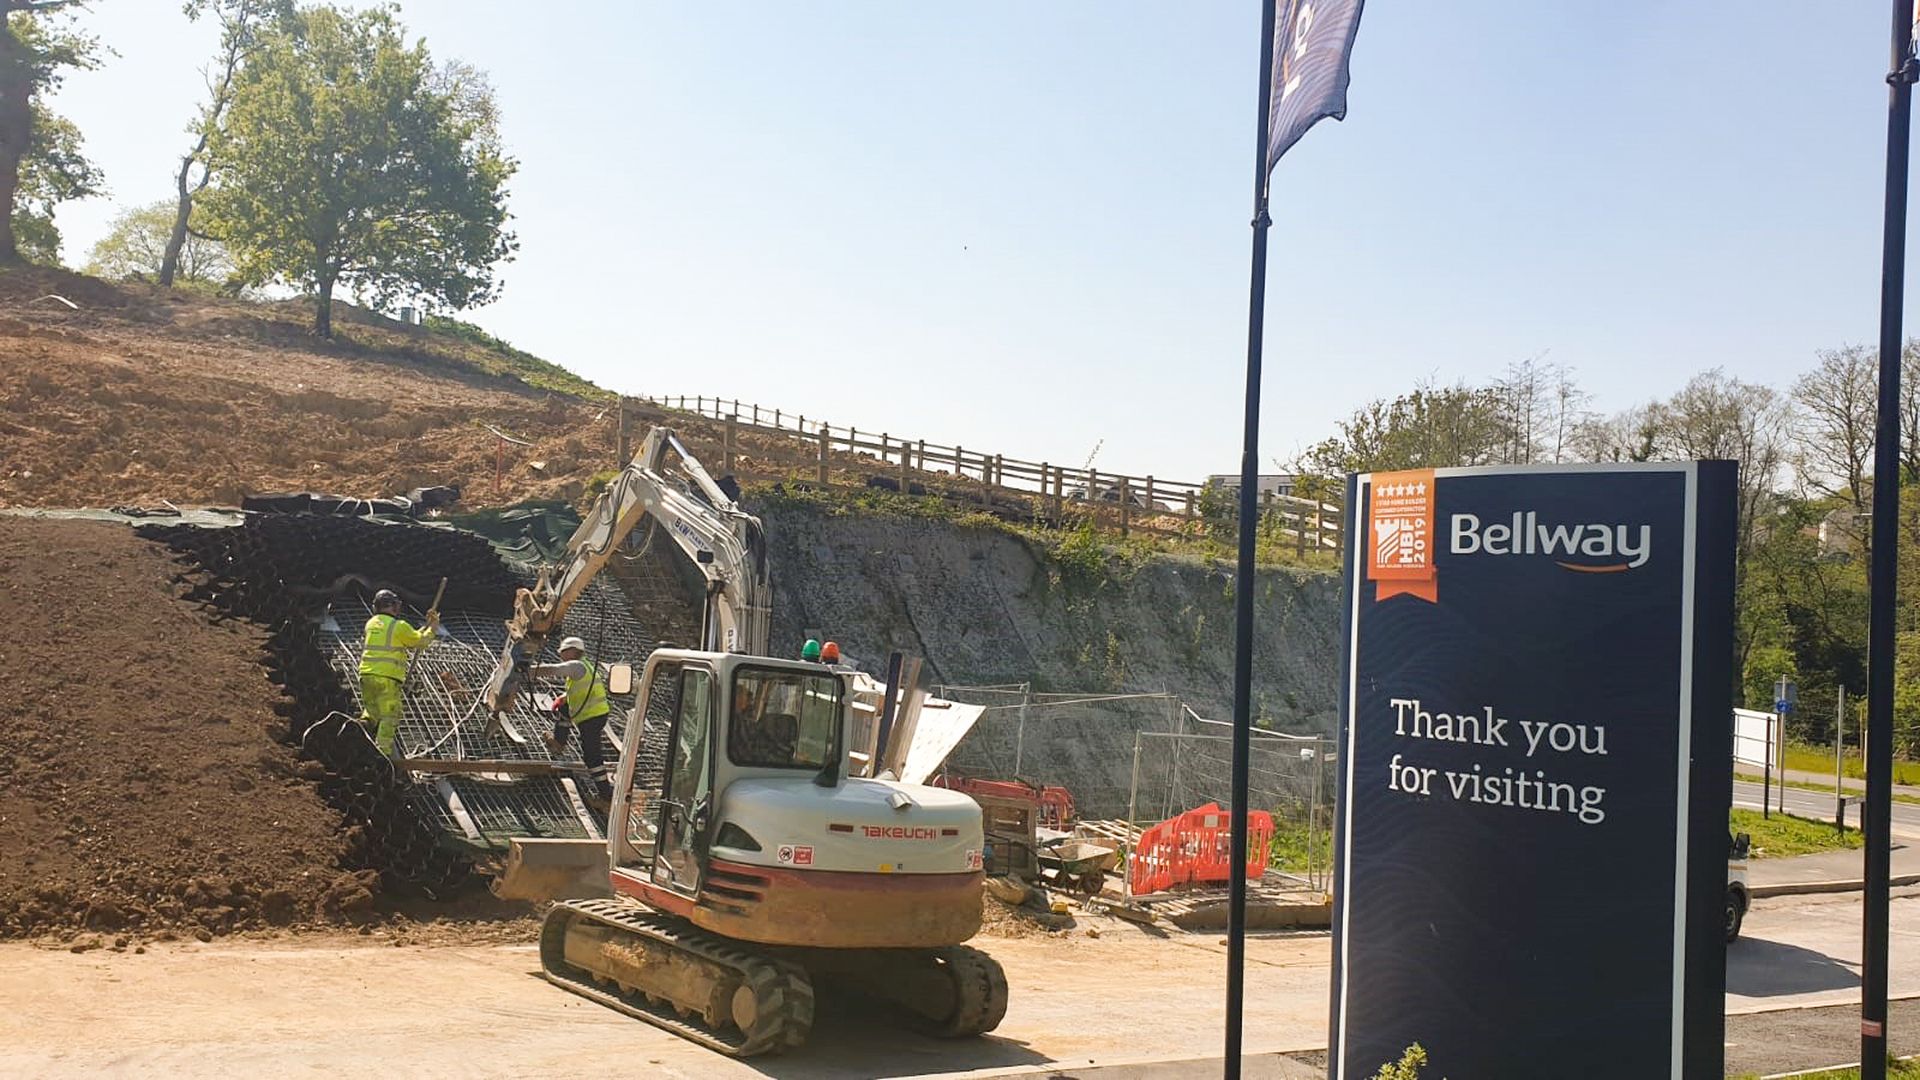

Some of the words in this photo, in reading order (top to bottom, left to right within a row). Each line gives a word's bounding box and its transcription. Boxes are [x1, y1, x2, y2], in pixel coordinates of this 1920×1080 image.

[1399, 518, 1414, 564] HBF
[1414, 518, 1426, 563] 2019
[1451, 511, 1651, 569] Bellway
[1390, 698, 1508, 746] Thank
[1519, 720, 1608, 757] you
[1388, 754, 1437, 795] for
[1445, 764, 1606, 824] visiting
[861, 825, 937, 839] TAKEUCHI
